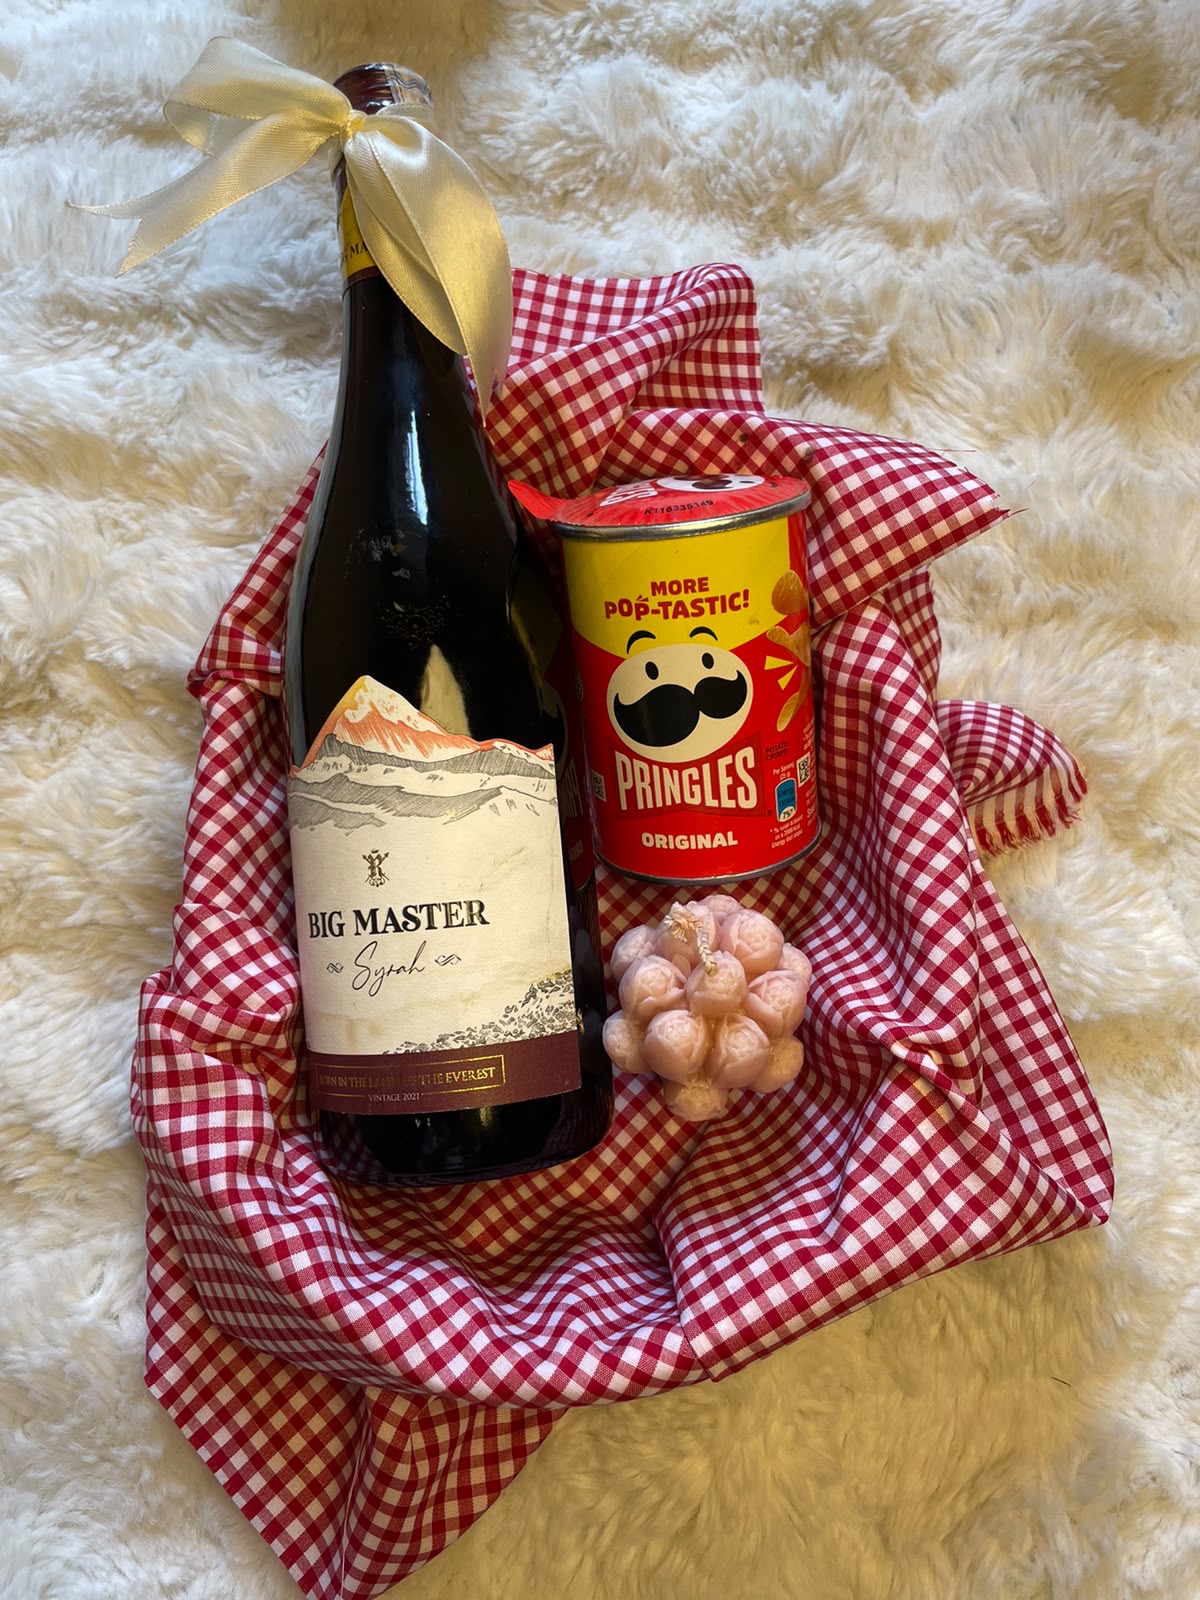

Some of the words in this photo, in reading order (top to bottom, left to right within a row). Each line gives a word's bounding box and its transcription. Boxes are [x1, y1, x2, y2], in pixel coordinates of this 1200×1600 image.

[650, 576, 710, 597] MORE
[604, 589, 750, 621] POP-TASTIC!
[614, 746, 758, 811] PRINGLES
[641, 831, 738, 850] ORIGINAL
[308, 910, 346, 939] BIG
[353, 899, 490, 936] MASTER
[351, 940, 427, 997] Syrah
[338, 1075, 348, 1088] IN
[348, 1076, 367, 1088] THE
[420, 1072, 444, 1085] THE
[445, 1066, 496, 1084] EVEREST
[368, 1093, 401, 1102] VINTAGE
[402, 1092, 420, 1101] 2021
